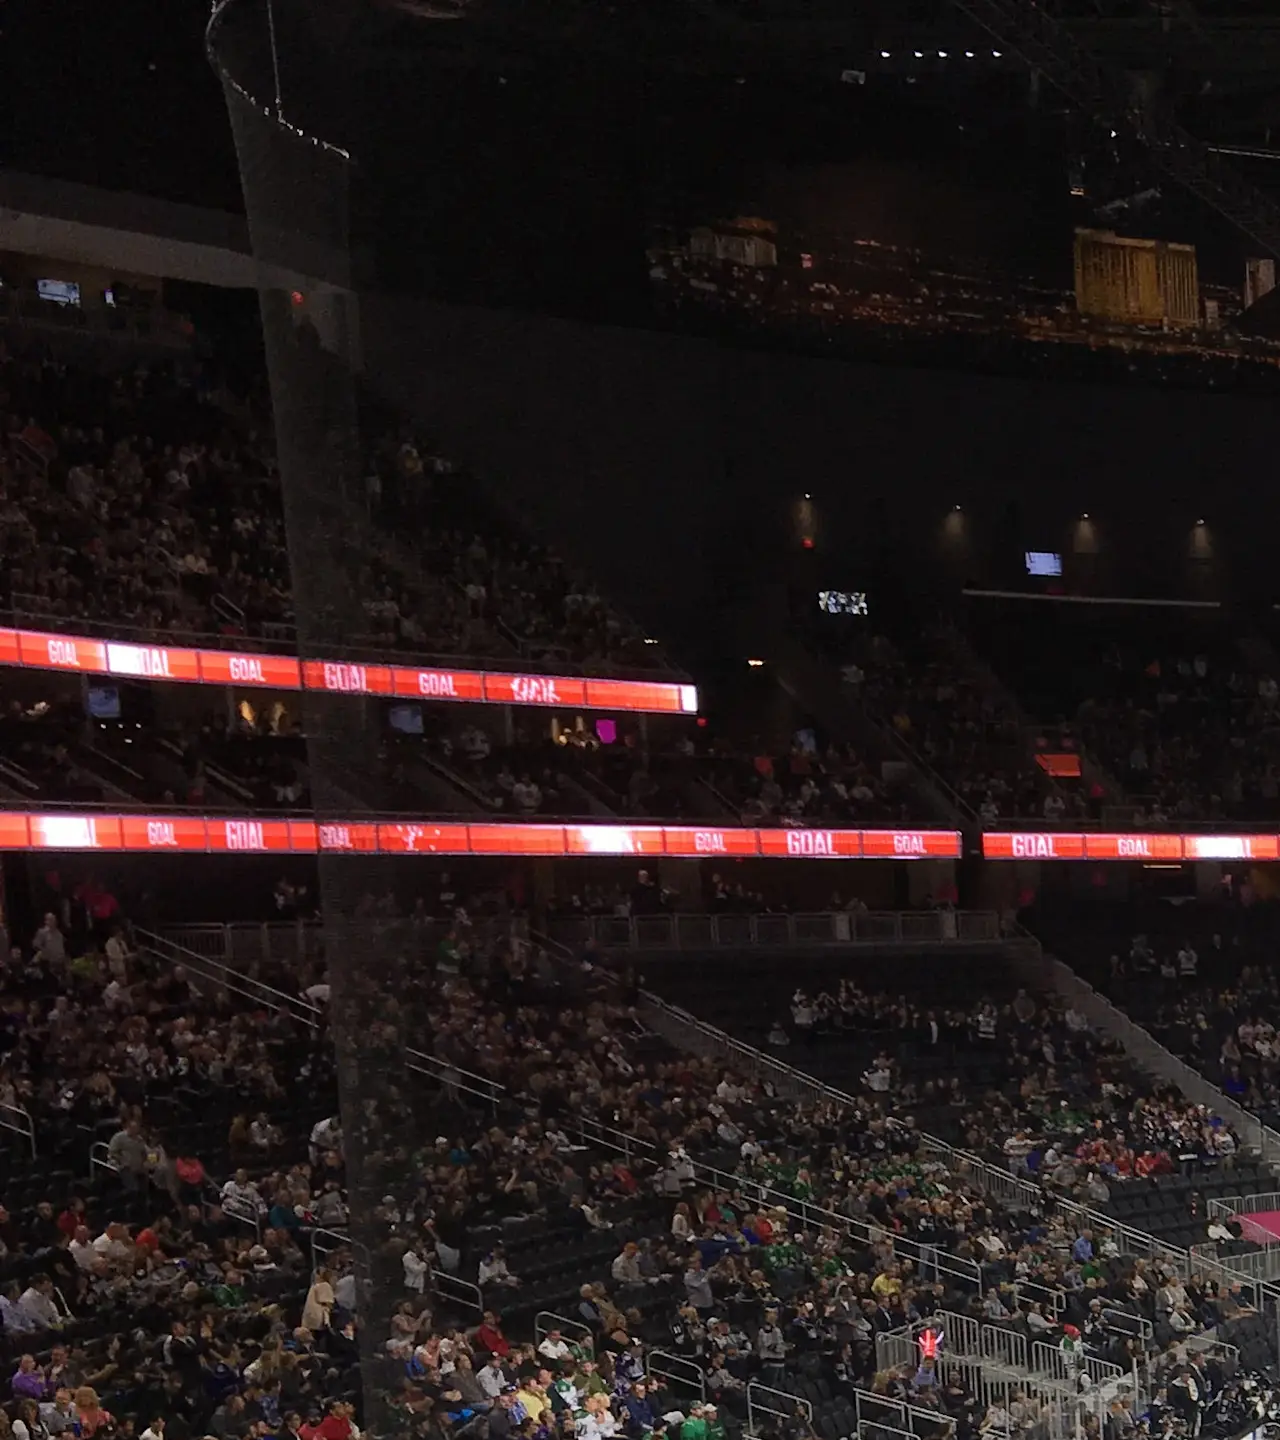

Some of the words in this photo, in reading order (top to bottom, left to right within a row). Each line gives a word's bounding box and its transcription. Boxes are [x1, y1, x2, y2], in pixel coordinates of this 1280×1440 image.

[48, 640, 80, 667] GOAL
[229, 658, 265, 681] GOAL
[324, 663, 371, 692] GOAL
[419, 672, 457, 696] GOAL
[147, 822, 178, 845] GOAL
[225, 821, 268, 849] GOAL
[694, 832, 726, 852] GOAL
[787, 831, 838, 855] GOAL
[894, 834, 927, 853] GOAL
[1012, 834, 1058, 857] GOAL
[1117, 838, 1151, 856] GOAL
